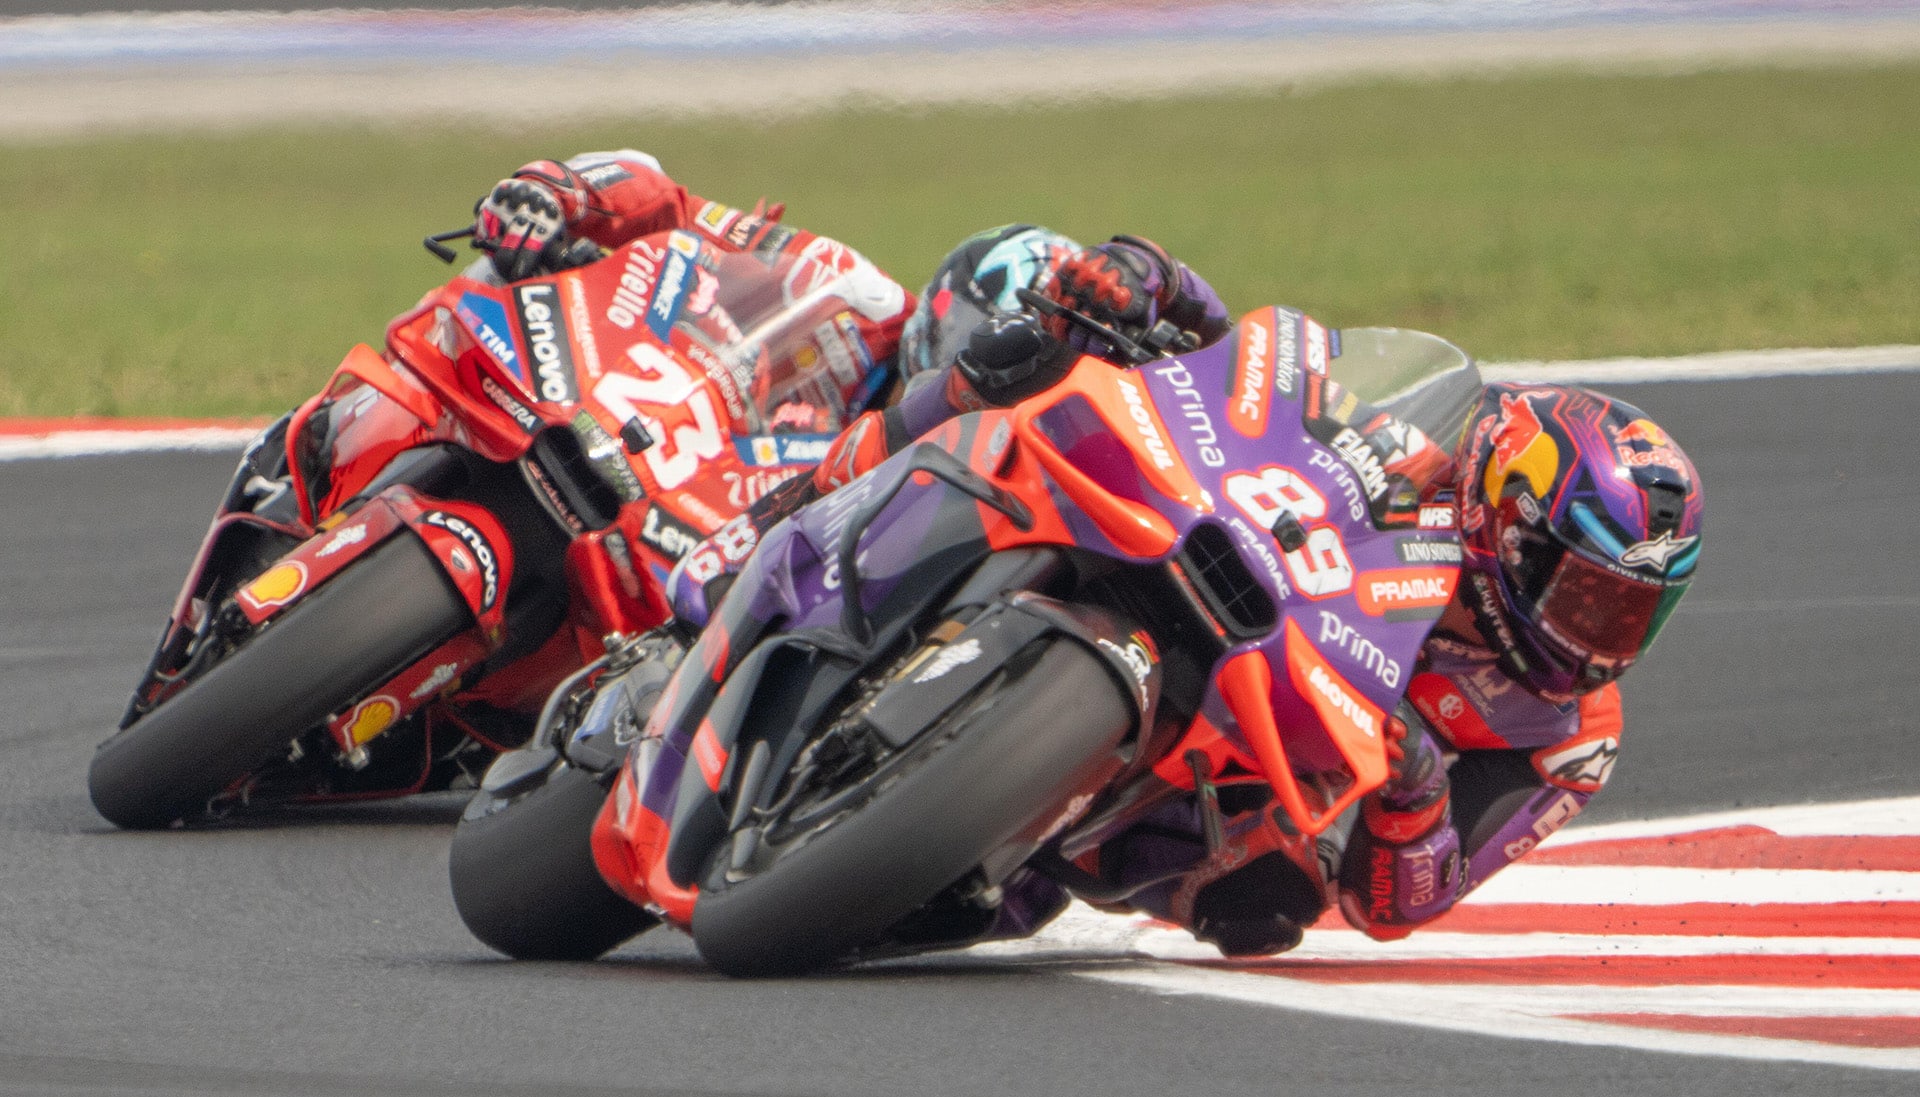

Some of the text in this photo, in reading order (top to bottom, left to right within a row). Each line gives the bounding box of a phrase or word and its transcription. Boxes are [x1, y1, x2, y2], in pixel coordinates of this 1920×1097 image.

[478, 323, 516, 364] TIM
[519, 284, 568, 402] Lenovo
[1239, 321, 1267, 420] PRAMAC
[590, 342, 725, 489] 23
[1117, 378, 1174, 470] MOTUL
[1154, 358, 1226, 468] prima
[1308, 449, 1365, 522] prima
[1332, 427, 1389, 501] FIAMM
[426, 511, 498, 607] Lenovo
[1225, 466, 1354, 597] 89
[1229, 517, 1291, 600] PRAMAC
[1370, 577, 1449, 603] PRAMAC
[1319, 610, 1401, 689] prima
[1309, 665, 1376, 738] MOTUL
